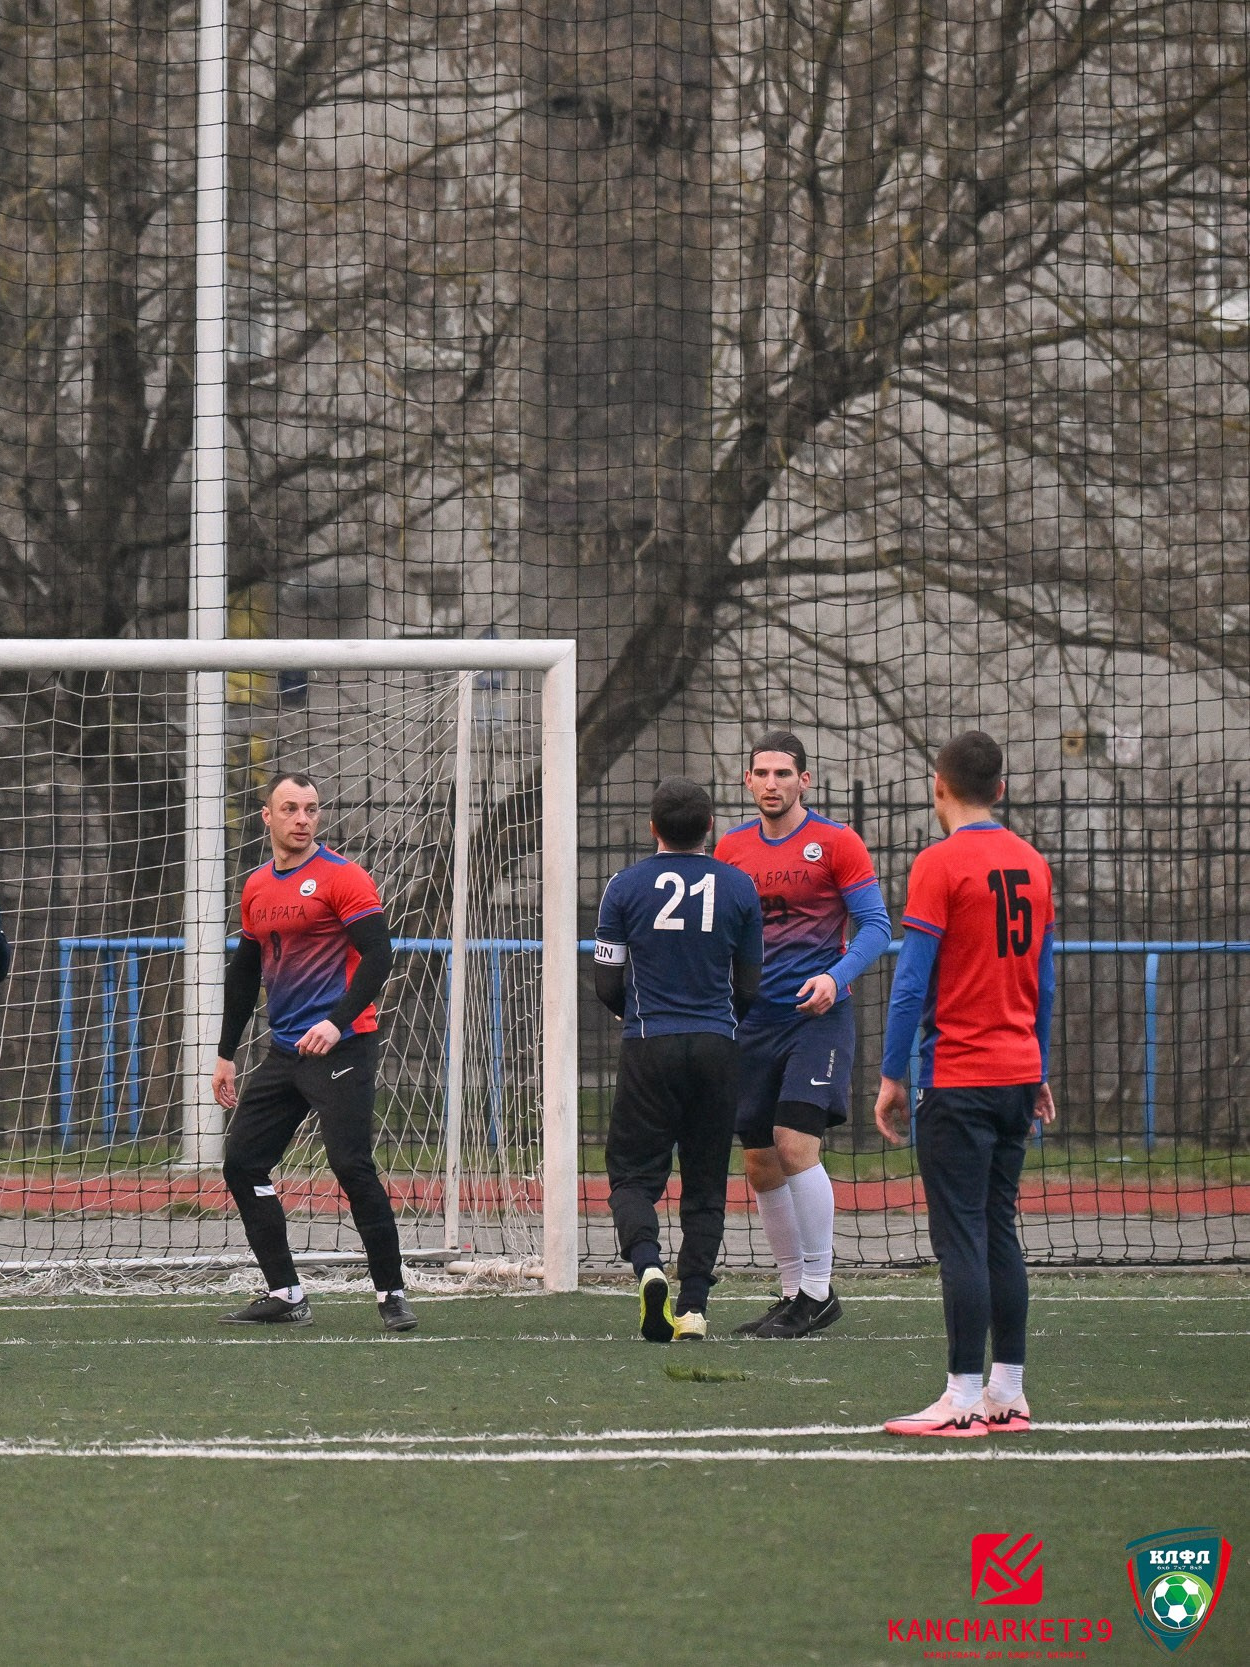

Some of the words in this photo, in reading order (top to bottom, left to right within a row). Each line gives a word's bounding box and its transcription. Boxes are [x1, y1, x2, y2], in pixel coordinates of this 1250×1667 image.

[765, 869, 812, 887] БРАТА
[270, 904, 307, 922] БРАТА
[652, 871, 716, 932] 21
[987, 869, 1033, 958] 15
